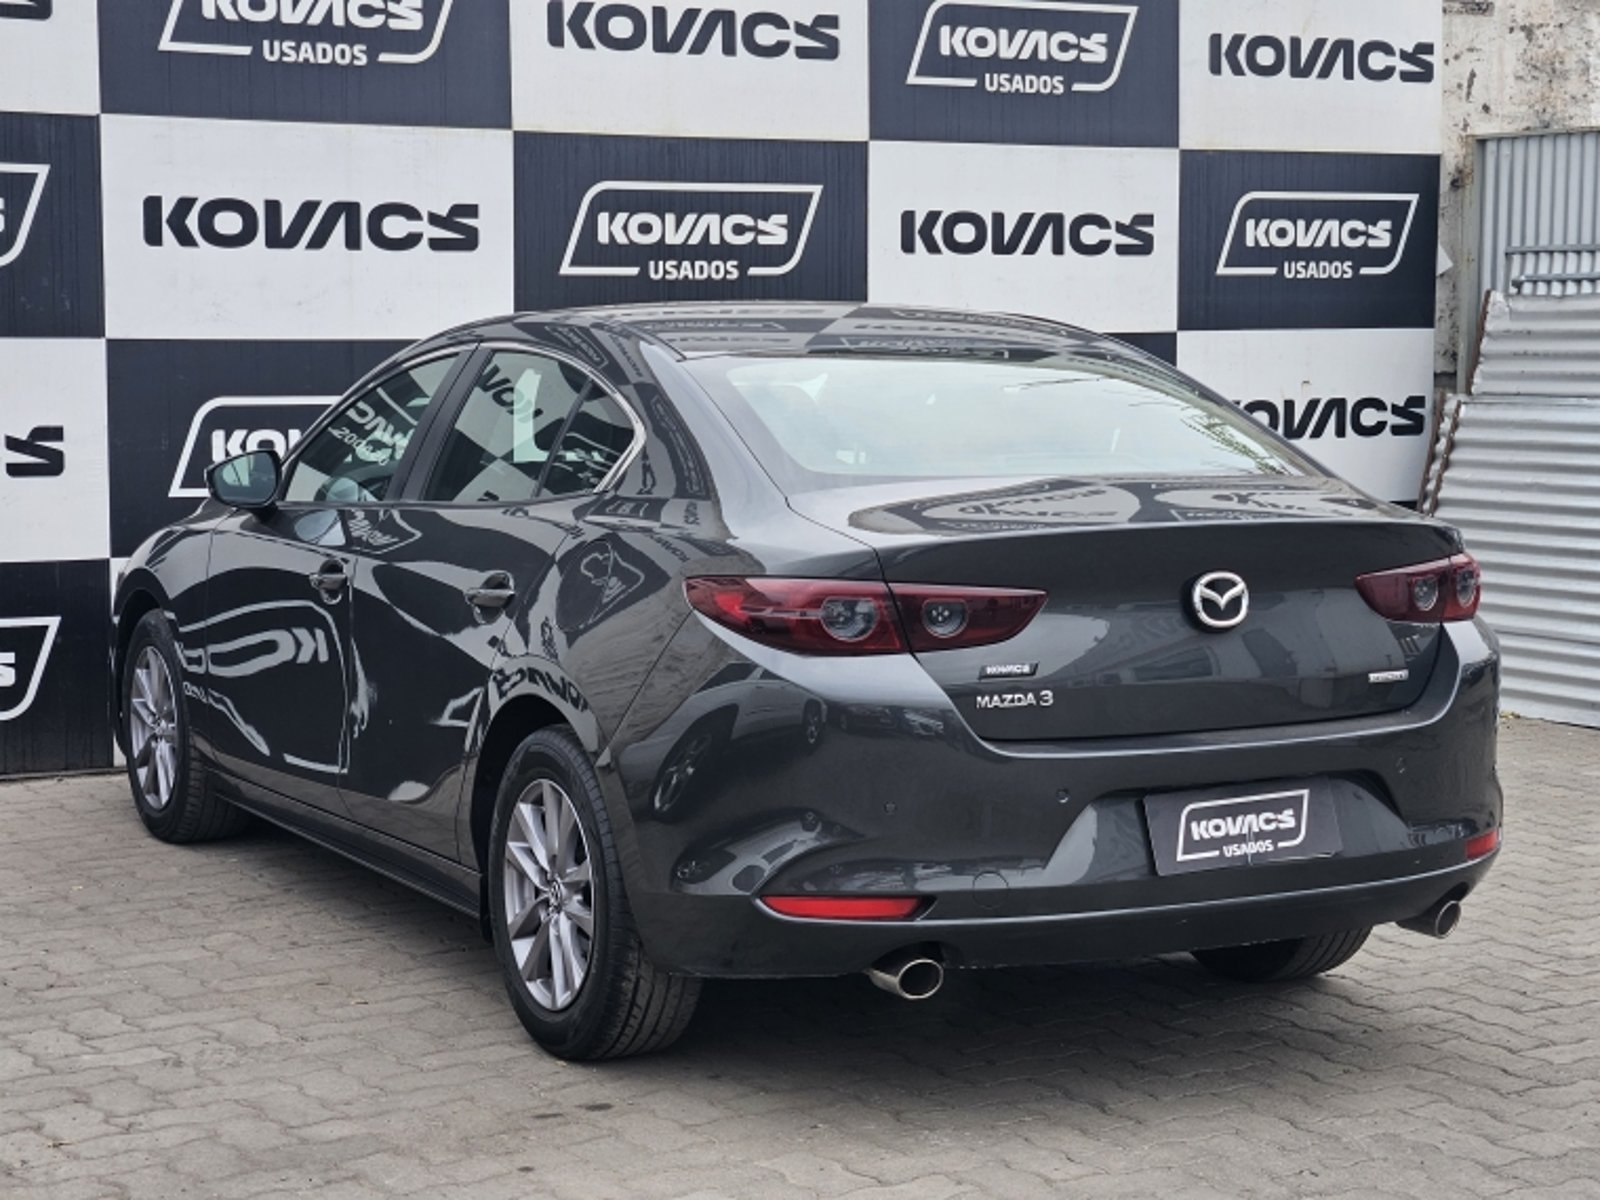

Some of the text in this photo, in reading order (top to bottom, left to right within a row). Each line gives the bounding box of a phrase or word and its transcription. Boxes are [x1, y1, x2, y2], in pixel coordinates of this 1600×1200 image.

[546, 1, 840, 61] KOVACS
[938, 24, 1108, 64] KOVACS
[262, 39, 368, 67] USADOS
[1208, 32, 1435, 84] KOVACS
[984, 72, 1065, 95] USADOS
[142, 195, 480, 253] KOVACS
[596, 211, 789, 247] KOVACS
[900, 210, 1155, 257] KOVACS
[1244, 218, 1392, 249] KOVACS
[648, 260, 740, 281] USADOS
[1283, 259, 1354, 280] USADOS
[1232, 395, 1427, 440] OVACS
[975, 689, 1054, 709] MAZDA 3
[1190, 807, 1297, 841] KOVACS
[1222, 839, 1275, 859] USADOS
